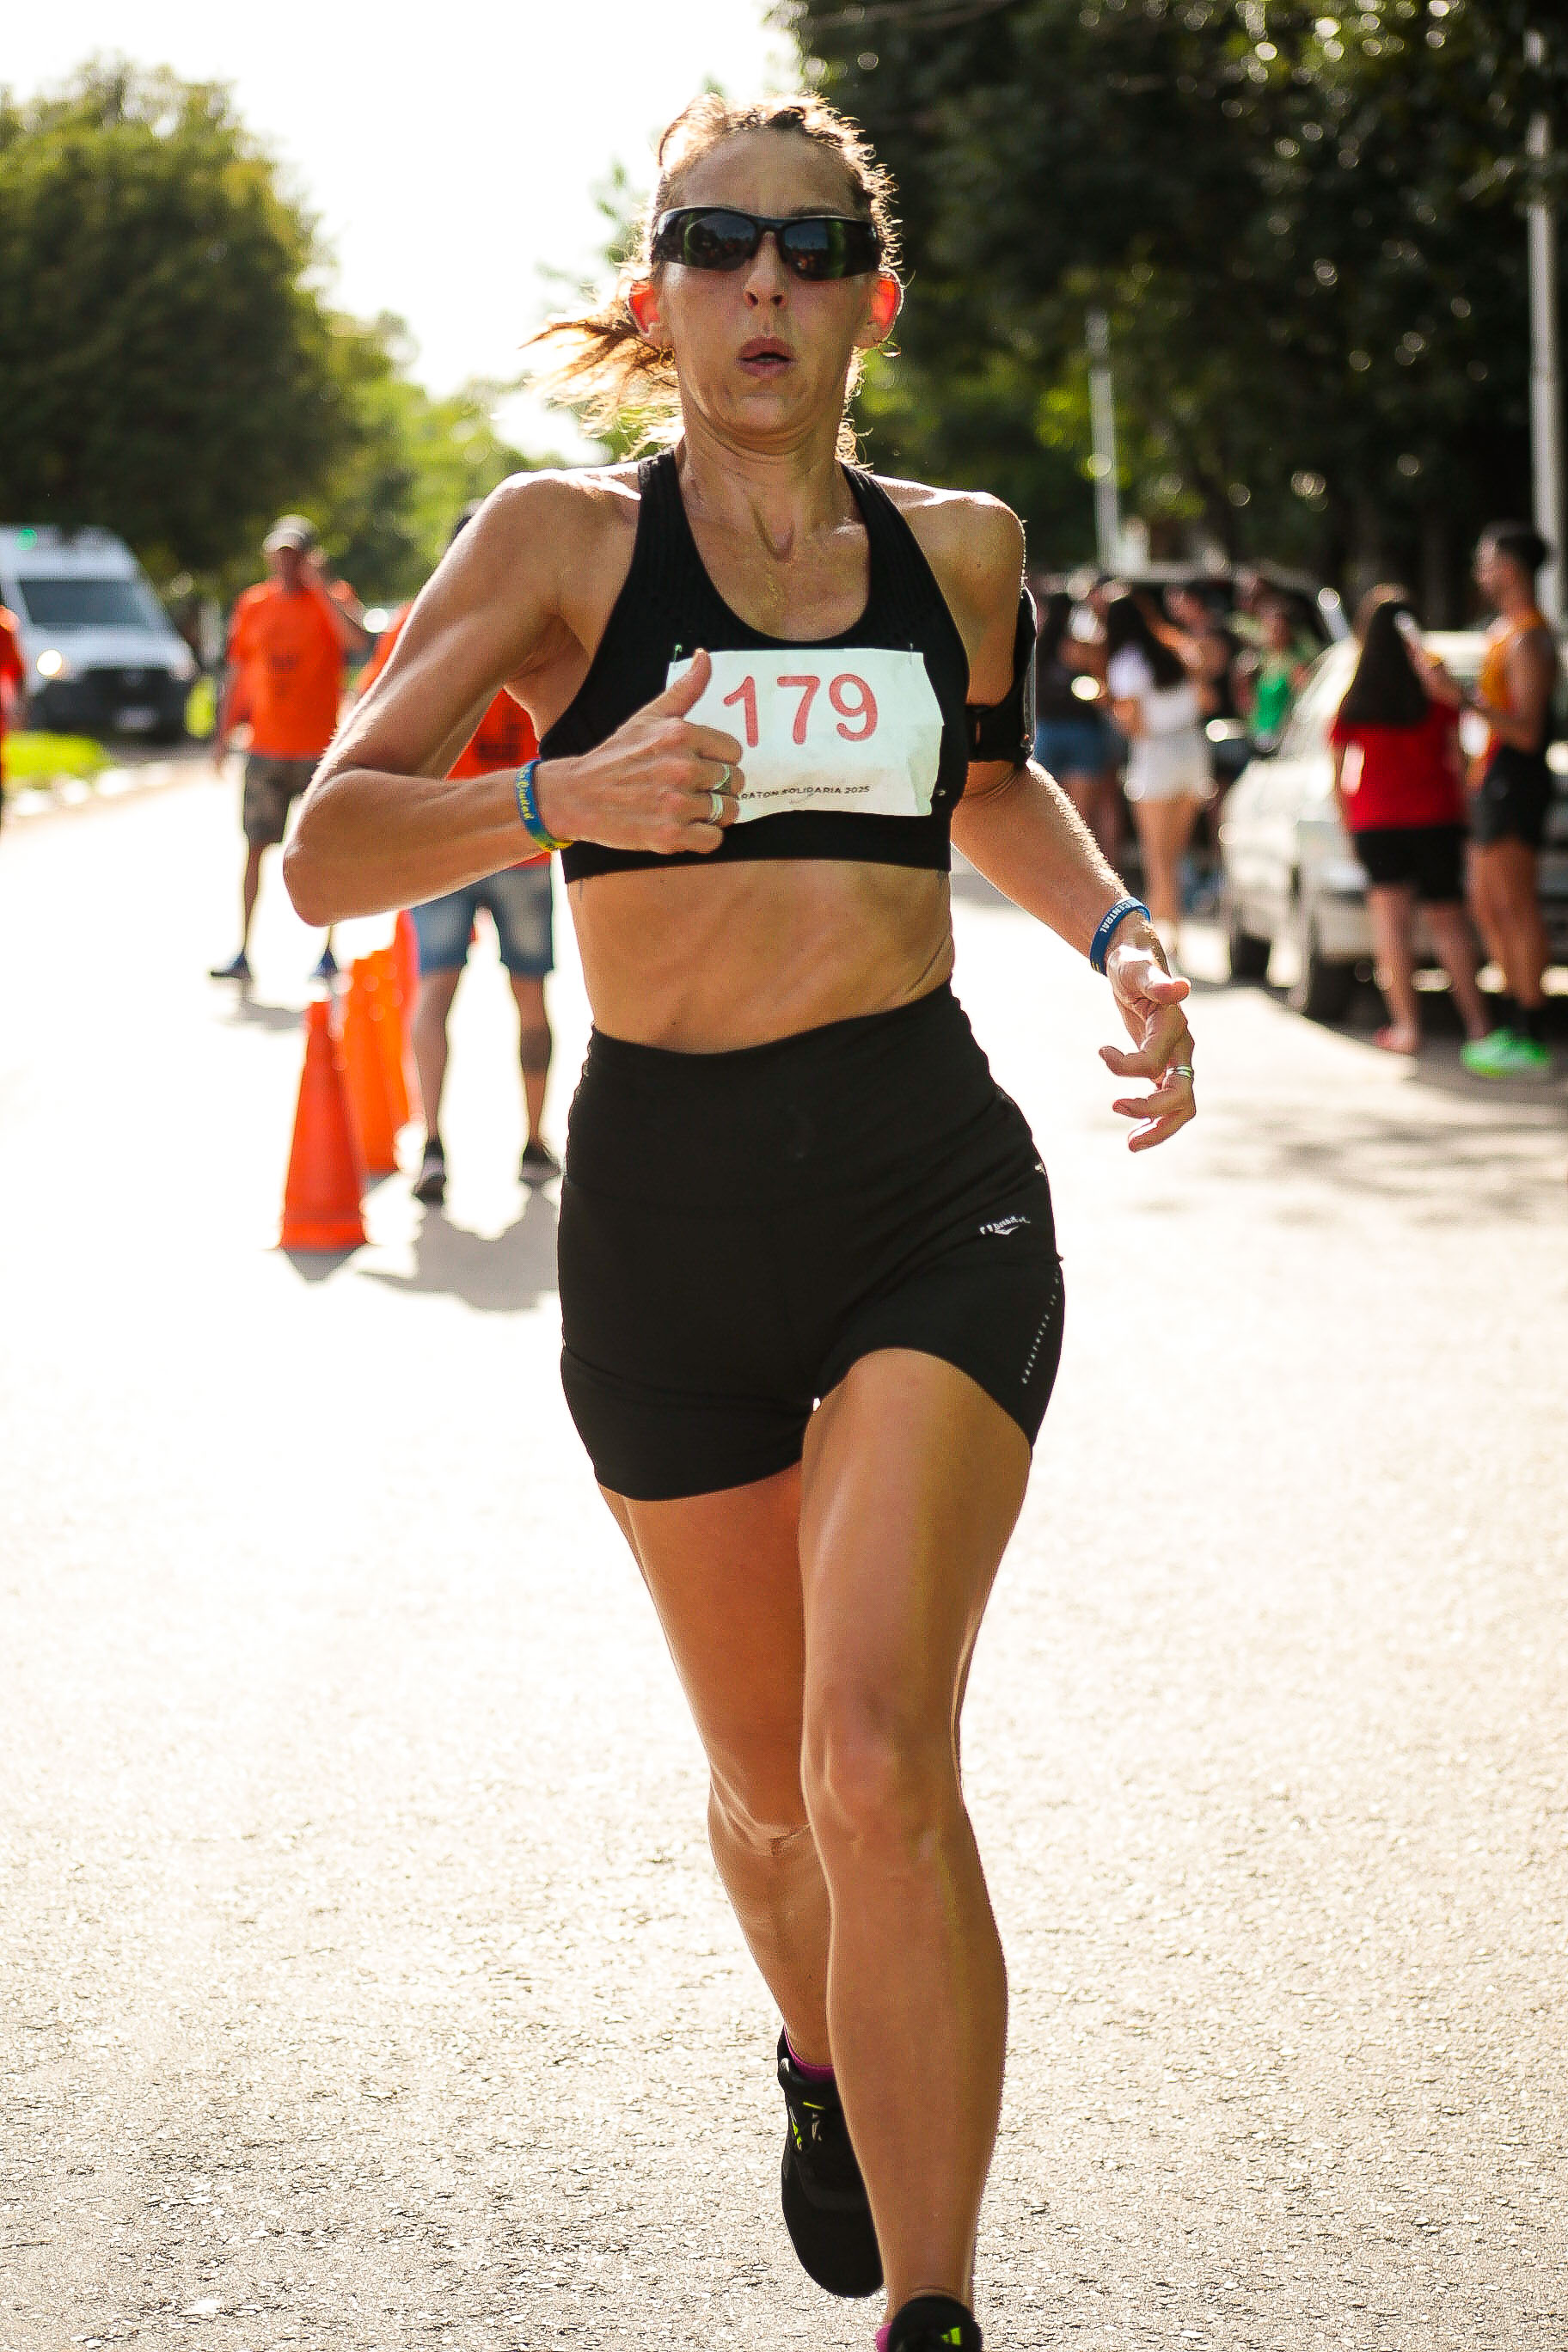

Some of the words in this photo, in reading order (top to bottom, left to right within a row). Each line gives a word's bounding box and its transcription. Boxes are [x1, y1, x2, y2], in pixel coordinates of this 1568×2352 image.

[723, 673, 878, 748] 179
[844, 785, 871, 794] 2025
[1099, 902, 1131, 934] CENTRAL
